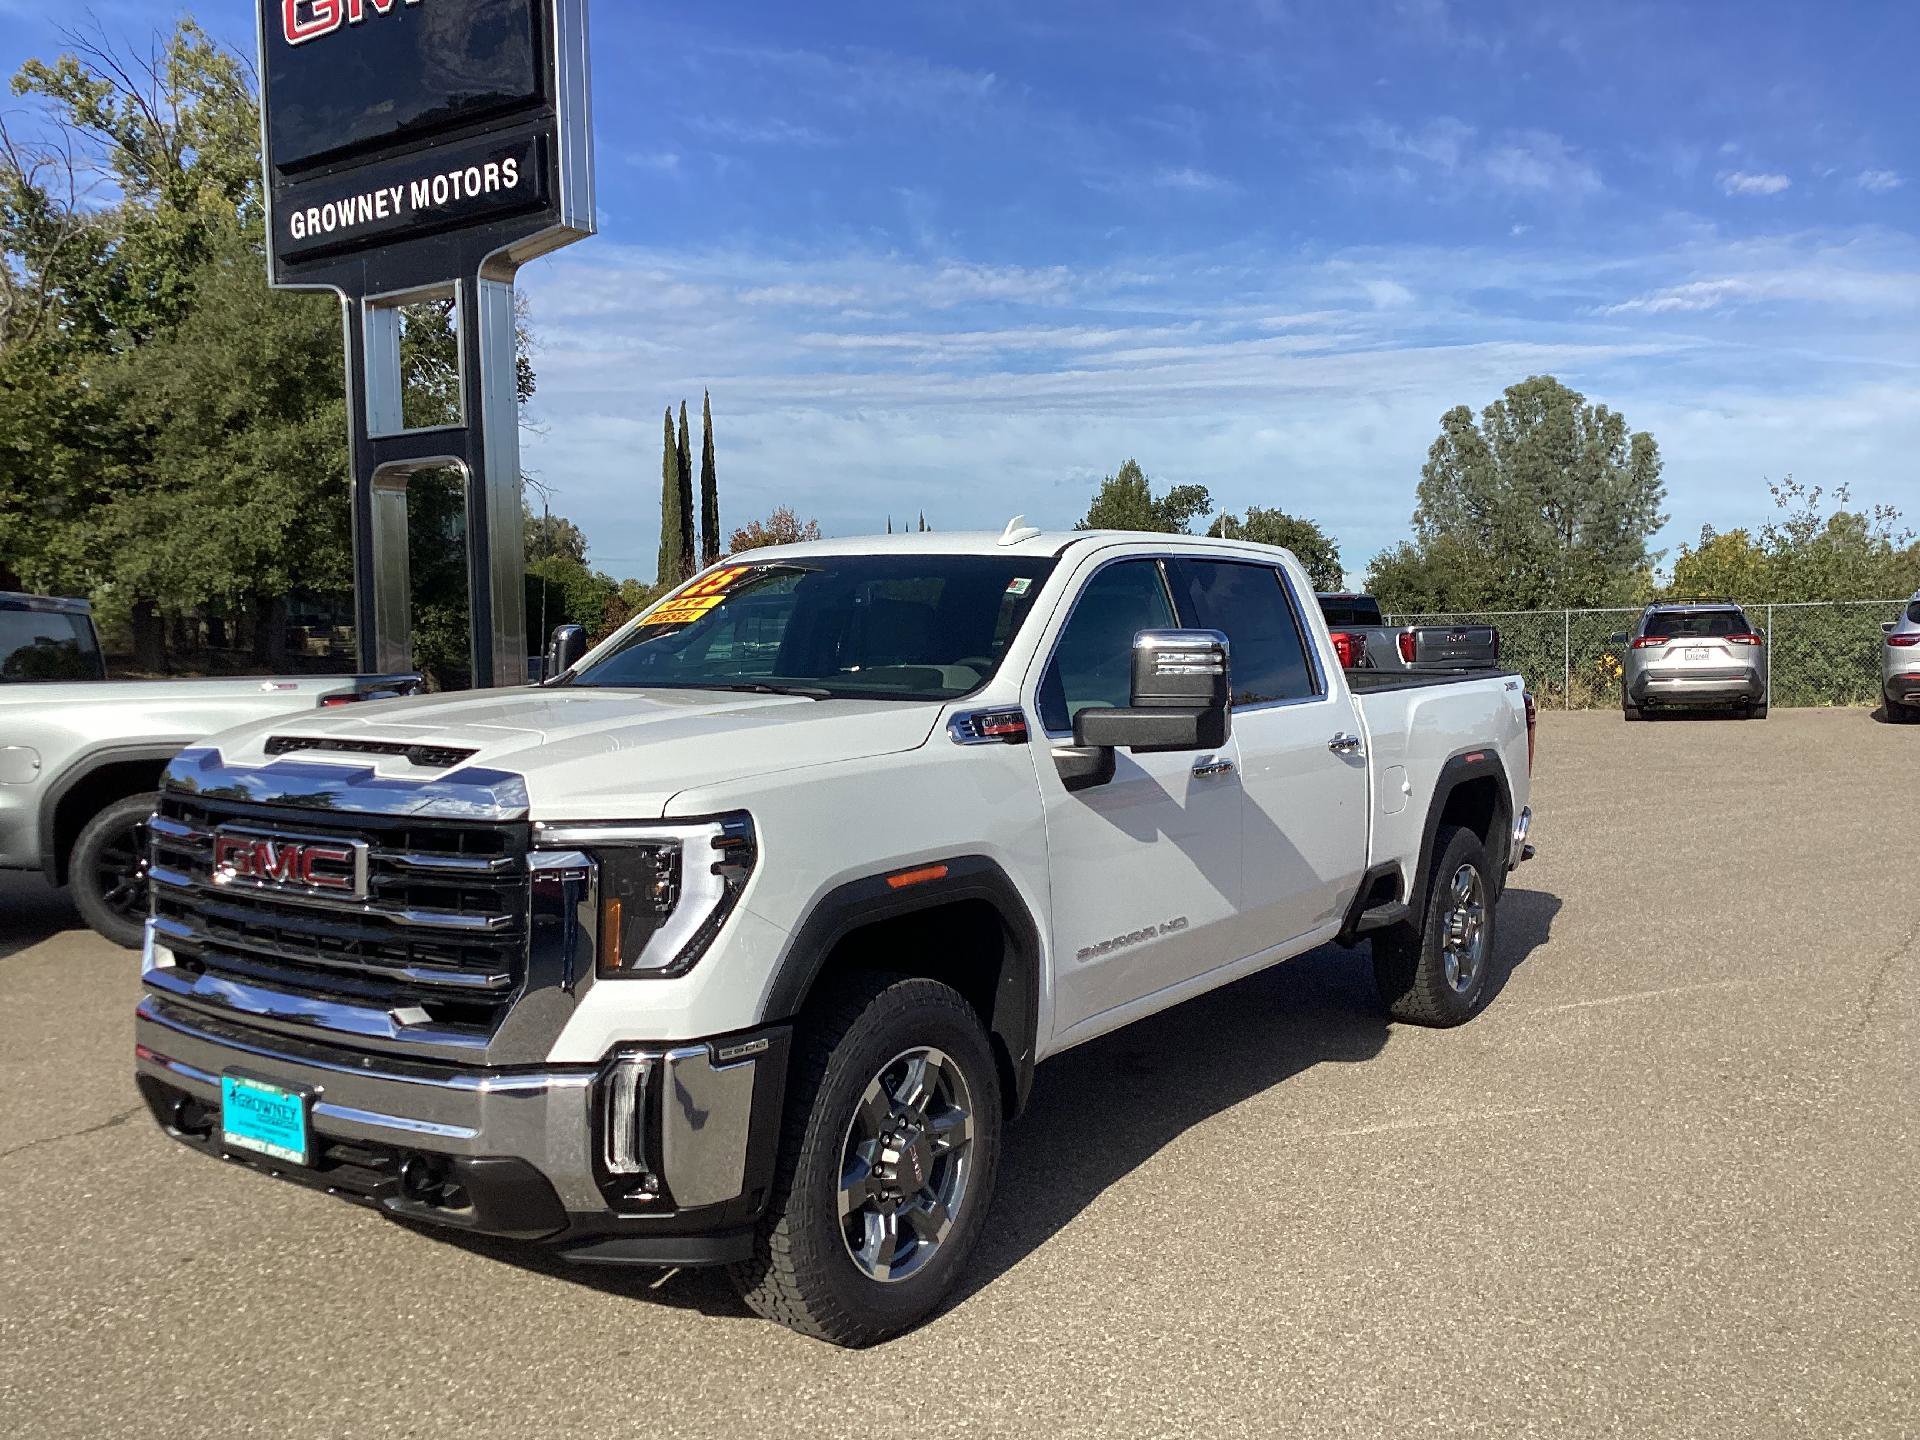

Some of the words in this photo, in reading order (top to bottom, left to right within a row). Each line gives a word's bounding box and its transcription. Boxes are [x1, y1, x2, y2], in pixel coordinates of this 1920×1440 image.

[290, 185, 404, 240] GROWNEY
[410, 158, 519, 210] MOTORS
[214, 836, 352, 890] GMC
[237, 1093, 297, 1120] GROWNEY
